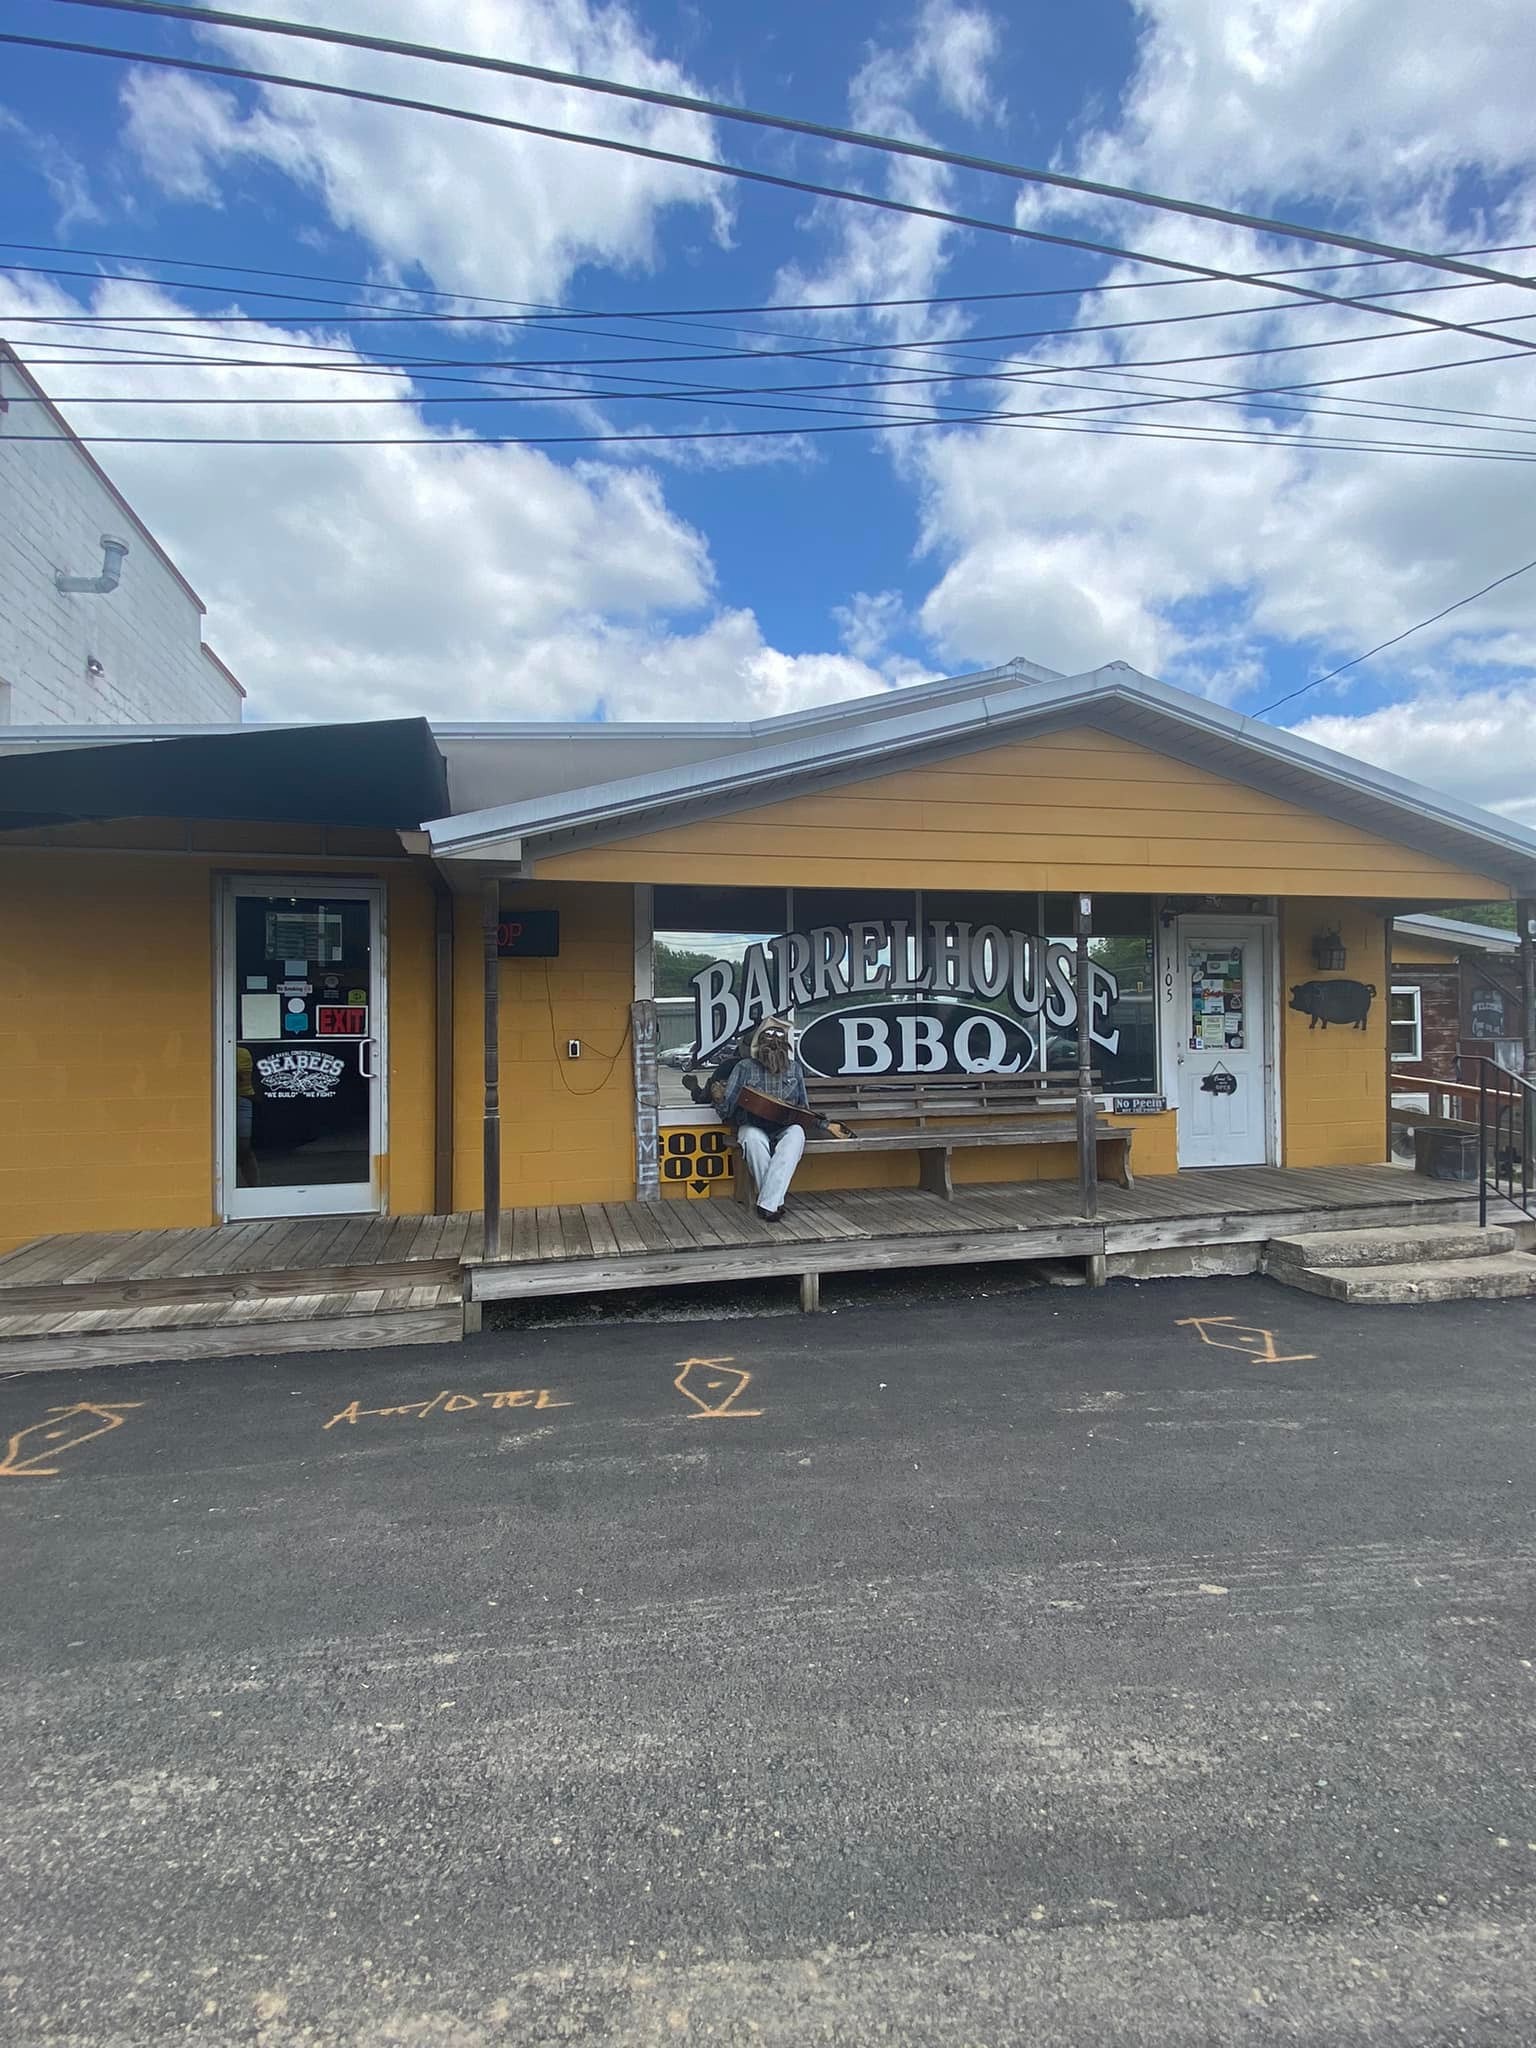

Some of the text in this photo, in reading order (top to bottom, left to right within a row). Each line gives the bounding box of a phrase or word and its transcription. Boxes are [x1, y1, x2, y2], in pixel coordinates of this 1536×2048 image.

[689, 919, 1121, 1062] BARRELHOUSE
[1164, 956, 1173, 1003] 105
[320, 1008, 363, 1033] EXIT
[256, 1055, 345, 1076] SEABEES
[837, 1015, 1022, 1075] BBQ
[634, 1020, 659, 1185] WELCOME
[1116, 1098, 1130, 1109] No
